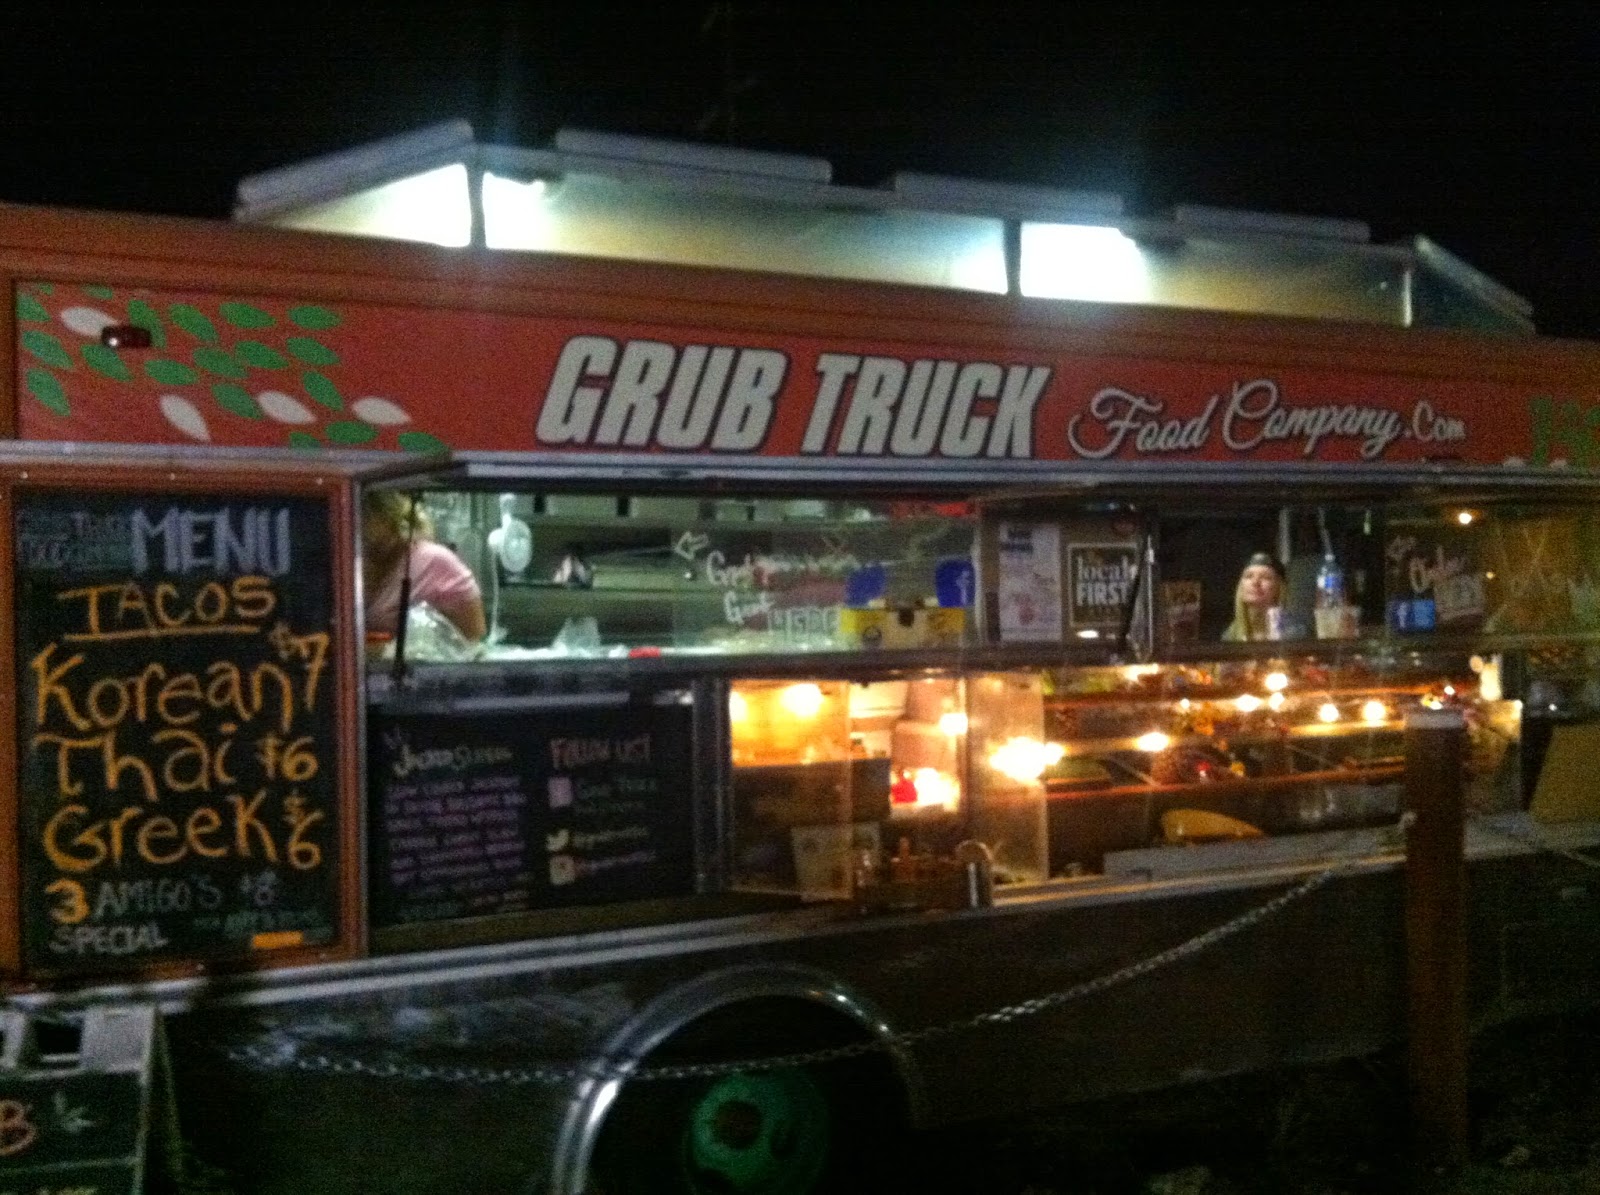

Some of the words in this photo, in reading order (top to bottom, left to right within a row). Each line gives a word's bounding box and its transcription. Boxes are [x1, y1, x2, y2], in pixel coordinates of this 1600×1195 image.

[535, 335, 789, 451] GRUB
[800, 352, 1052, 459] TRUCK
[1066, 386, 1221, 459] Food
[131, 506, 291, 576] MENU
[56, 575, 277, 637] TACOS
[1075, 580, 1132, 608] FIRST
[31, 641, 294, 735] Korean
[32, 720, 238, 802] Thai
[43, 788, 279, 872] Greek
[46, 878, 89, 924] 3
[50, 918, 169, 955] SPECIAL
